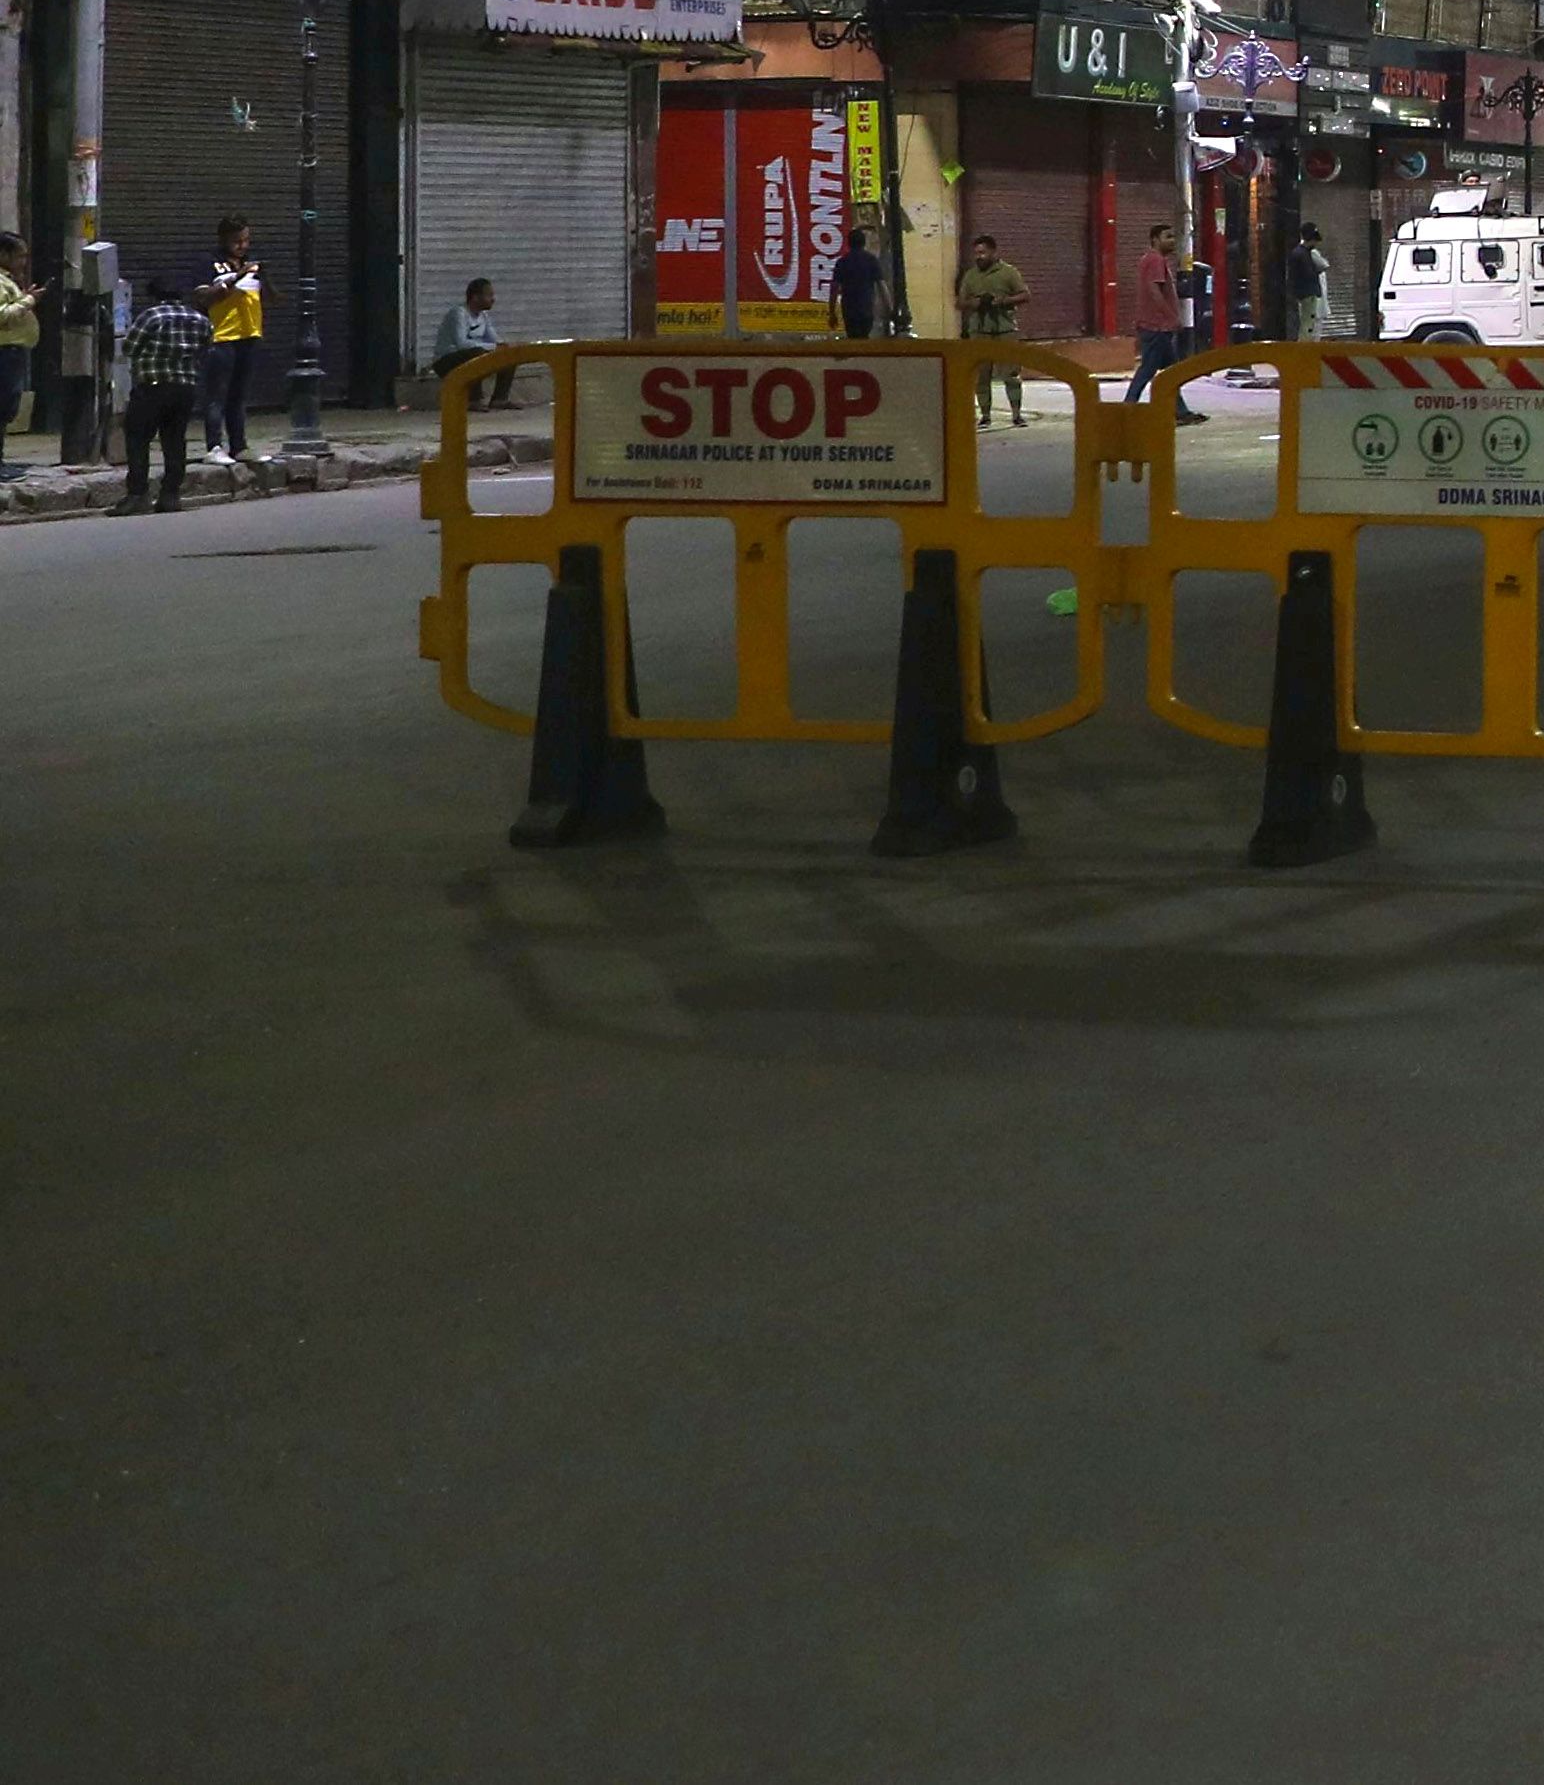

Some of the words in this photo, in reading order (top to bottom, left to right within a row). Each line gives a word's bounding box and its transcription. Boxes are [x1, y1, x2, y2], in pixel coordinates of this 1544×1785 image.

[1057, 24, 1078, 74] U
[1087, 28, 1108, 77] &
[1116, 32, 1128, 78] I
[857, 103, 872, 134] NEW
[764, 154, 784, 266] RUPA
[640, 366, 881, 439] STOP
[1414, 395, 1478, 411] COVID-19
[1481, 396, 1531, 412] SAFETY
[625, 443, 698, 461] SRINAGAR
[702, 444, 755, 462] POLICE
[758, 445, 777, 462] AT
[780, 445, 823, 462] YOUR
[828, 445, 894, 462] SERVICE
[813, 478, 854, 490] DDMA
[858, 479, 932, 491] SRINAGAR
[1438, 488, 1487, 506] DDMA
